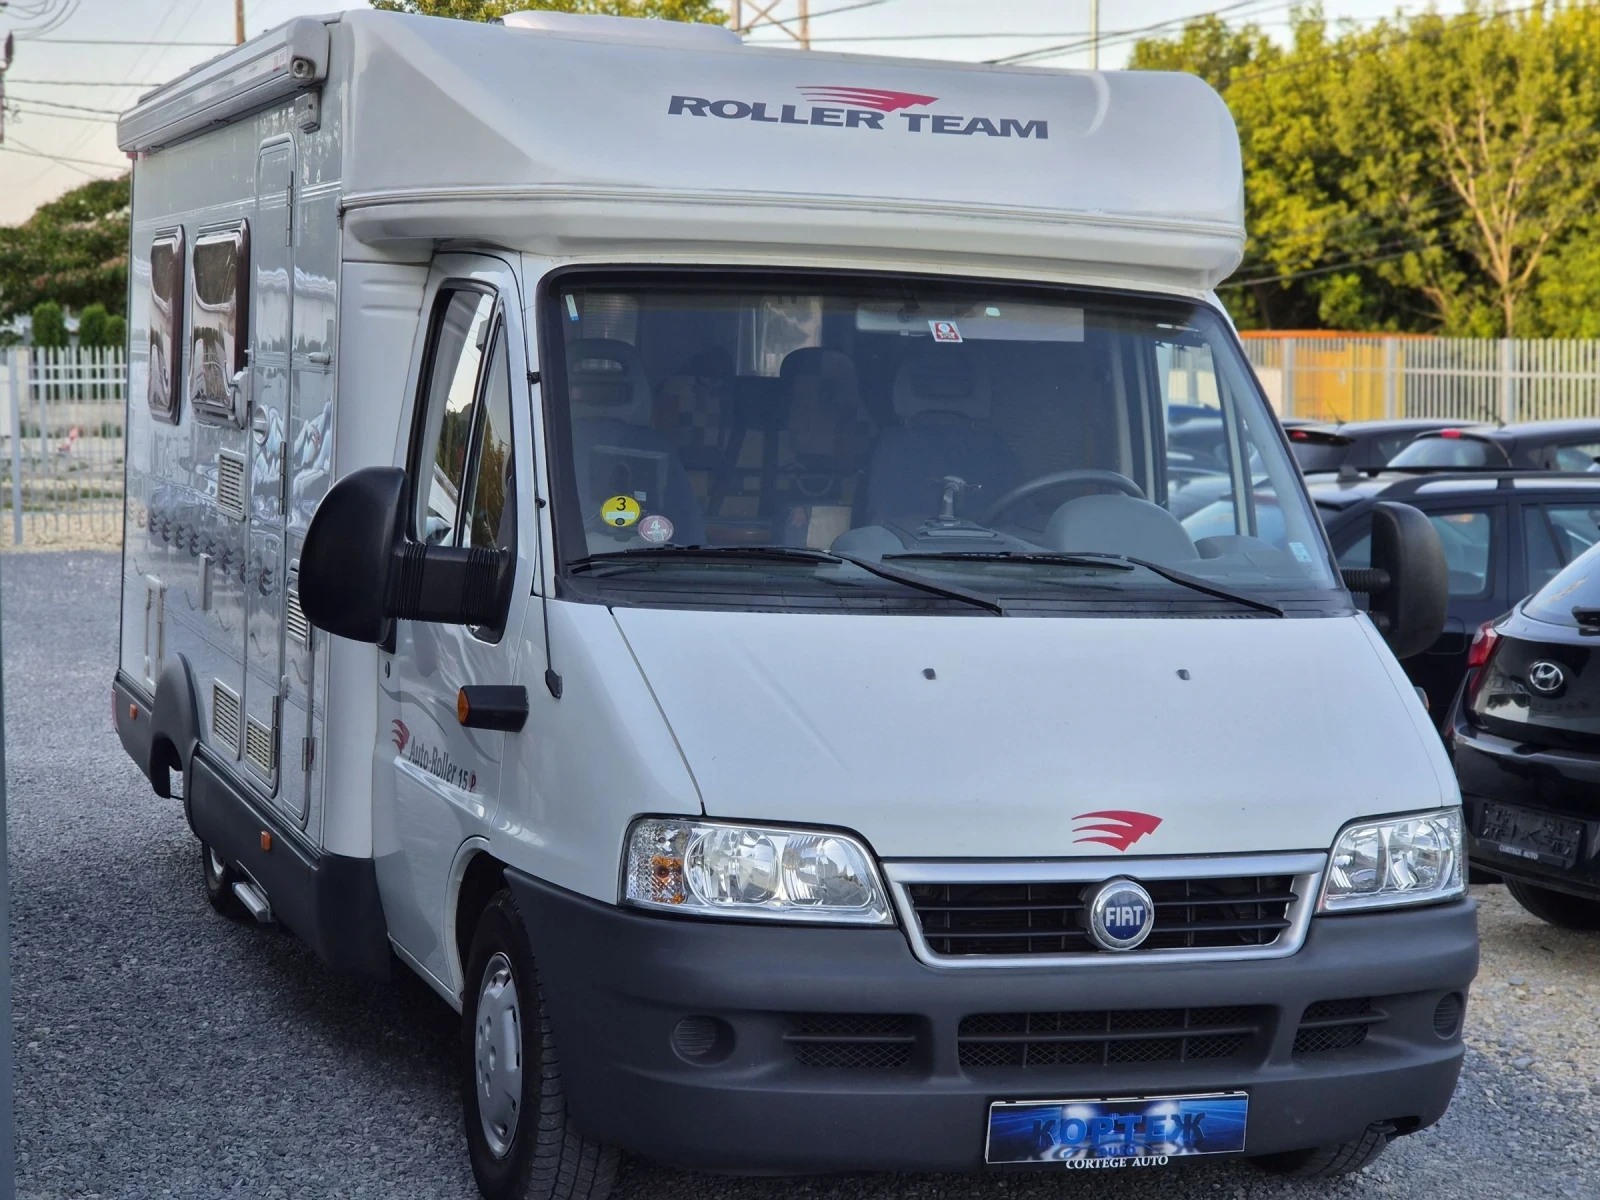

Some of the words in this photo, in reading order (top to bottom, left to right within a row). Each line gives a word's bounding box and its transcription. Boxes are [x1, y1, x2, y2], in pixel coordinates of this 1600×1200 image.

[667, 95, 885, 130] ROLLER
[899, 112, 1049, 140] TEAM
[616, 497, 627, 511] 3
[651, 520, 661, 530] 4
[409, 736, 457, 784] Auto-Roller
[458, 768, 469, 790] 15
[1105, 905, 1144, 927] FIAT
[1032, 1112, 1206, 1146] КОРТЕЖ
[1065, 1158, 1127, 1170] CORTEGE
[1131, 1155, 1169, 1168] AUTO
